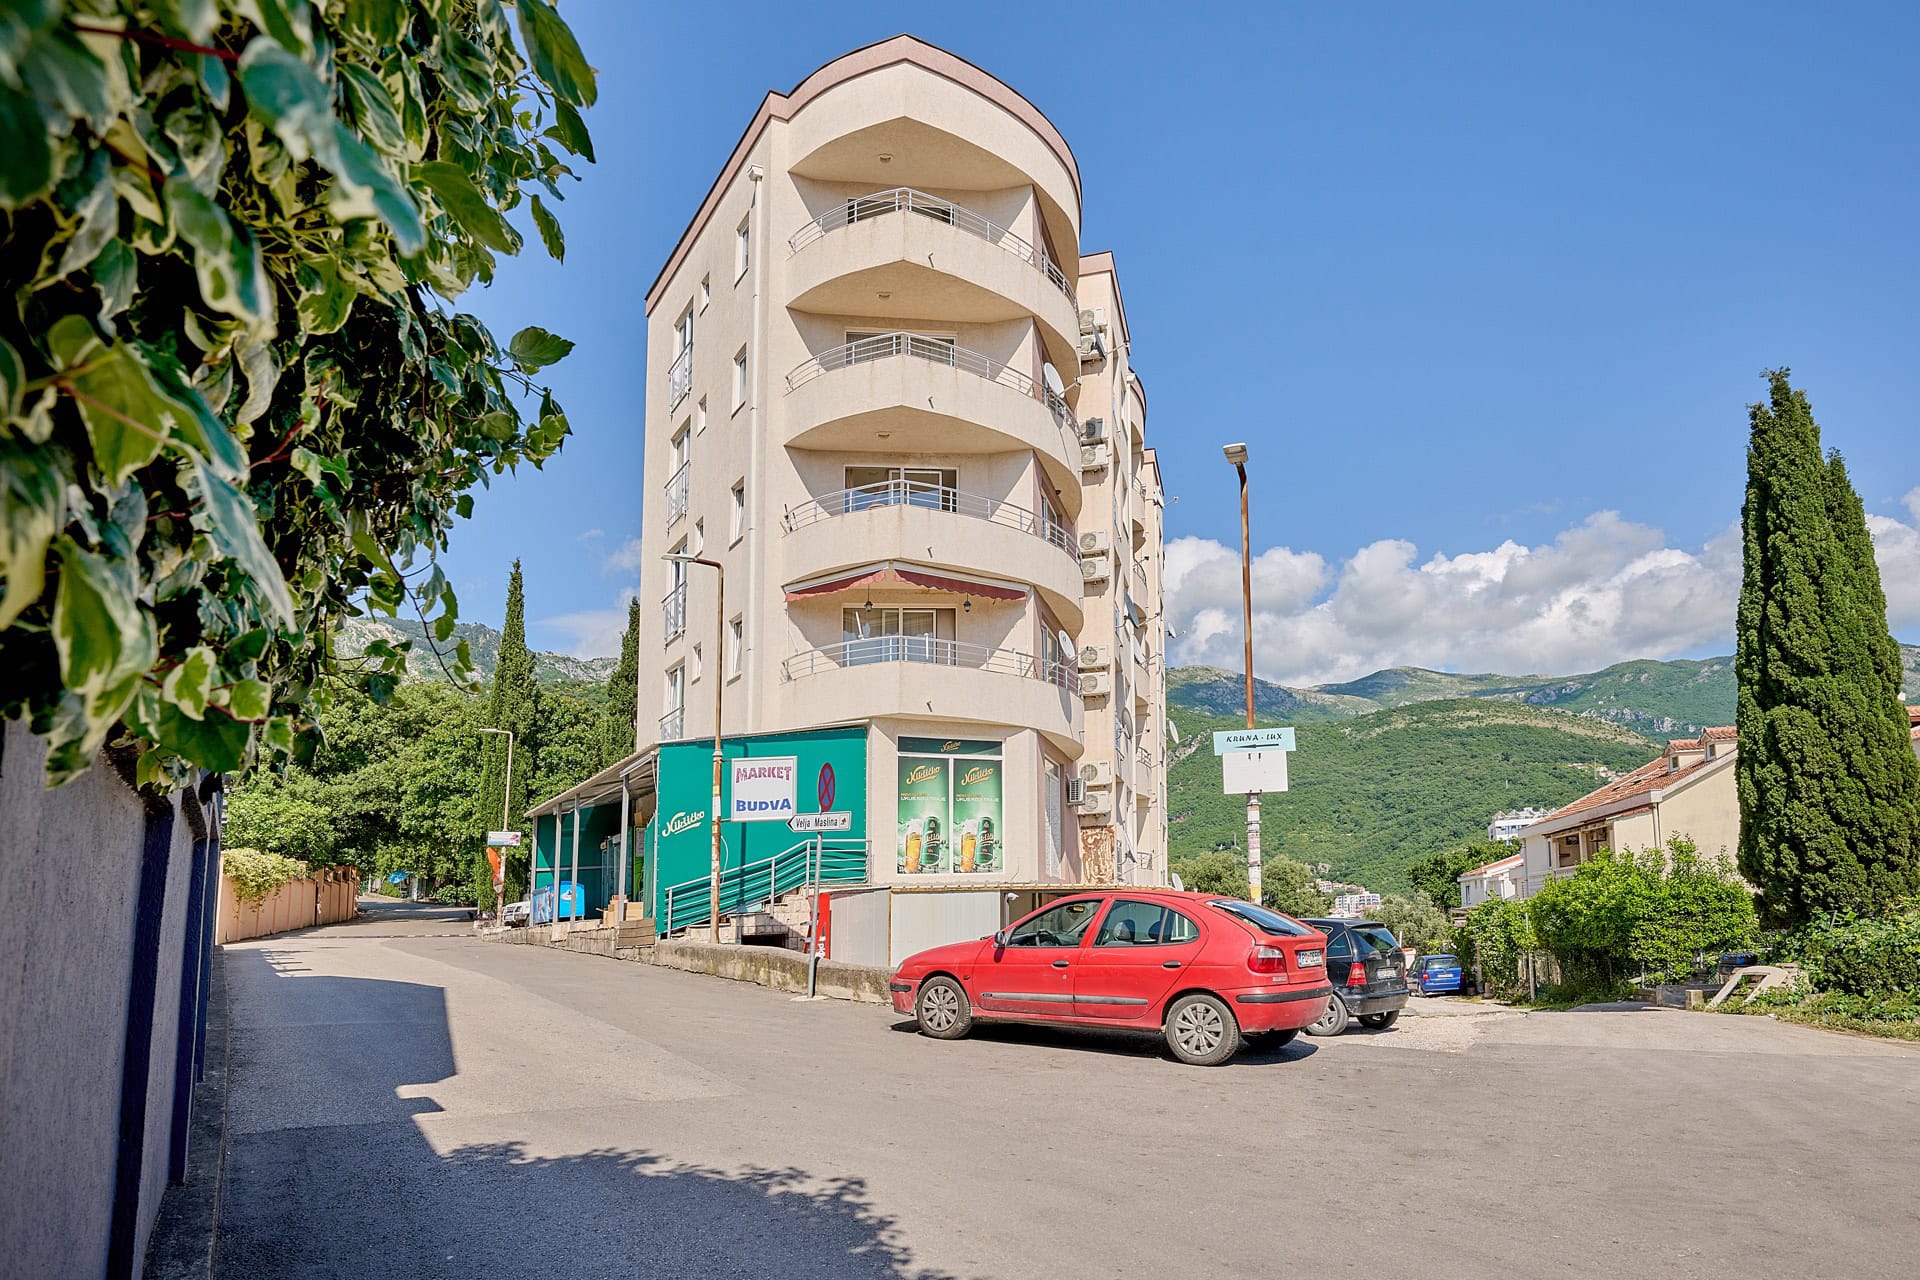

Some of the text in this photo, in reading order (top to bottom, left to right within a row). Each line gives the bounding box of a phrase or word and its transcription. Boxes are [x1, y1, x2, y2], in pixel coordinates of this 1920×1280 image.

[1226, 734, 1259, 743] KRUNA
[736, 766, 792, 783] MARKET
[736, 798, 792, 812] BUDVA
[796, 818, 838, 829] Velja Maslina
